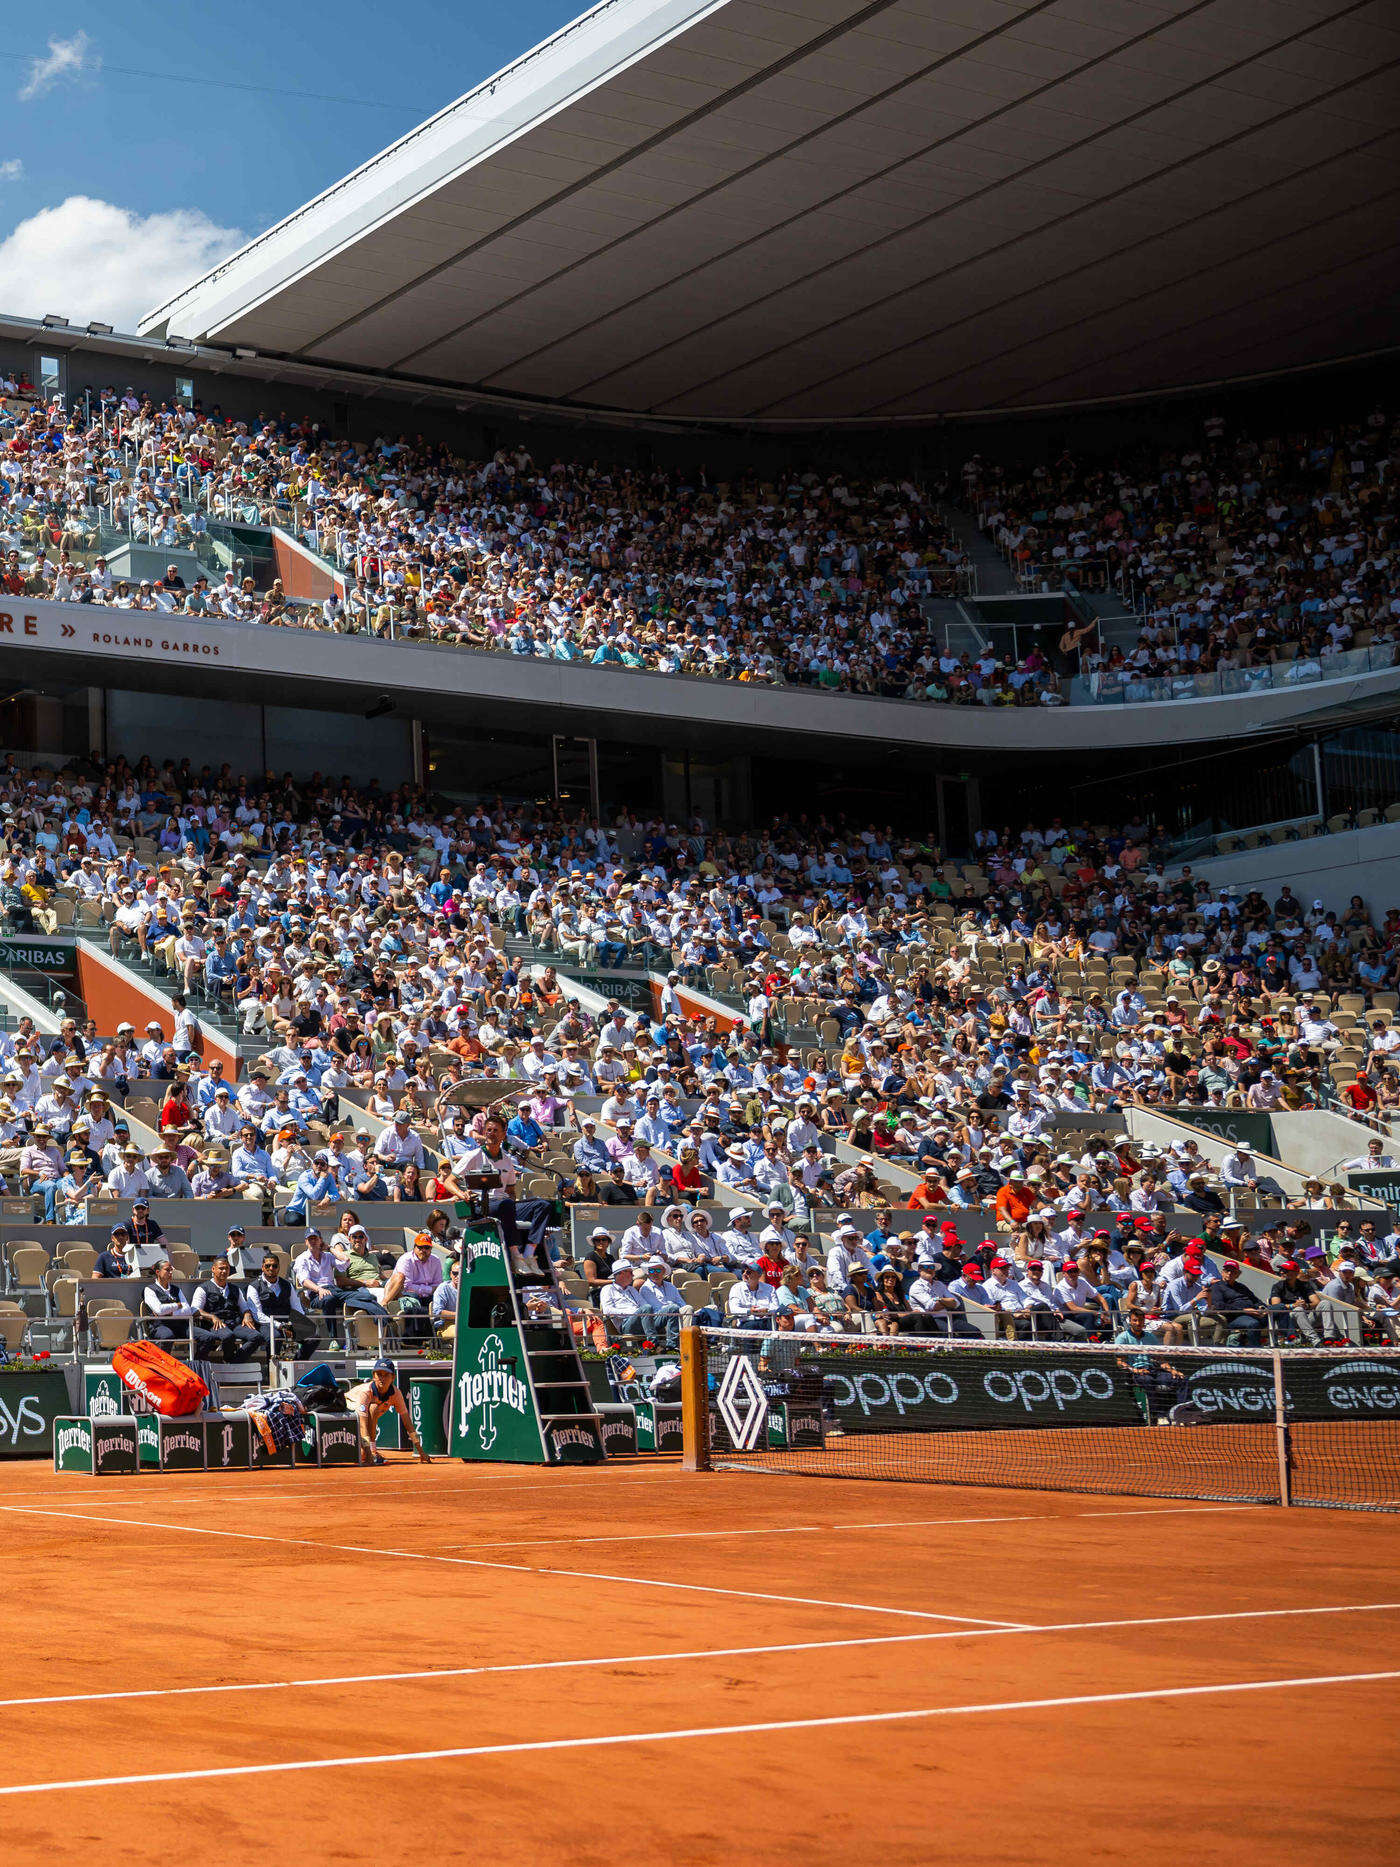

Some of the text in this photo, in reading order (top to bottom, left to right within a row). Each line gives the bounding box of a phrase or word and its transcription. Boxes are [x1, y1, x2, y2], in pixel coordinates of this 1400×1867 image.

[93, 632, 153, 648] ROLAND
[161, 640, 220, 656] GARROS
[466, 1237, 501, 1274] perrier
[458, 1363, 528, 1438] perrier
[983, 1368, 1115, 1412] oppo
[57, 1422, 91, 1469] perrier
[138, 1425, 159, 1448] rrier
[162, 1430, 201, 1464] perrier
[321, 1427, 357, 1458] perrier
[551, 1424, 595, 1460] perrier
[601, 1420, 634, 1447] perrier
[658, 1417, 683, 1446] perri
[96, 1433, 136, 1466] perrier
